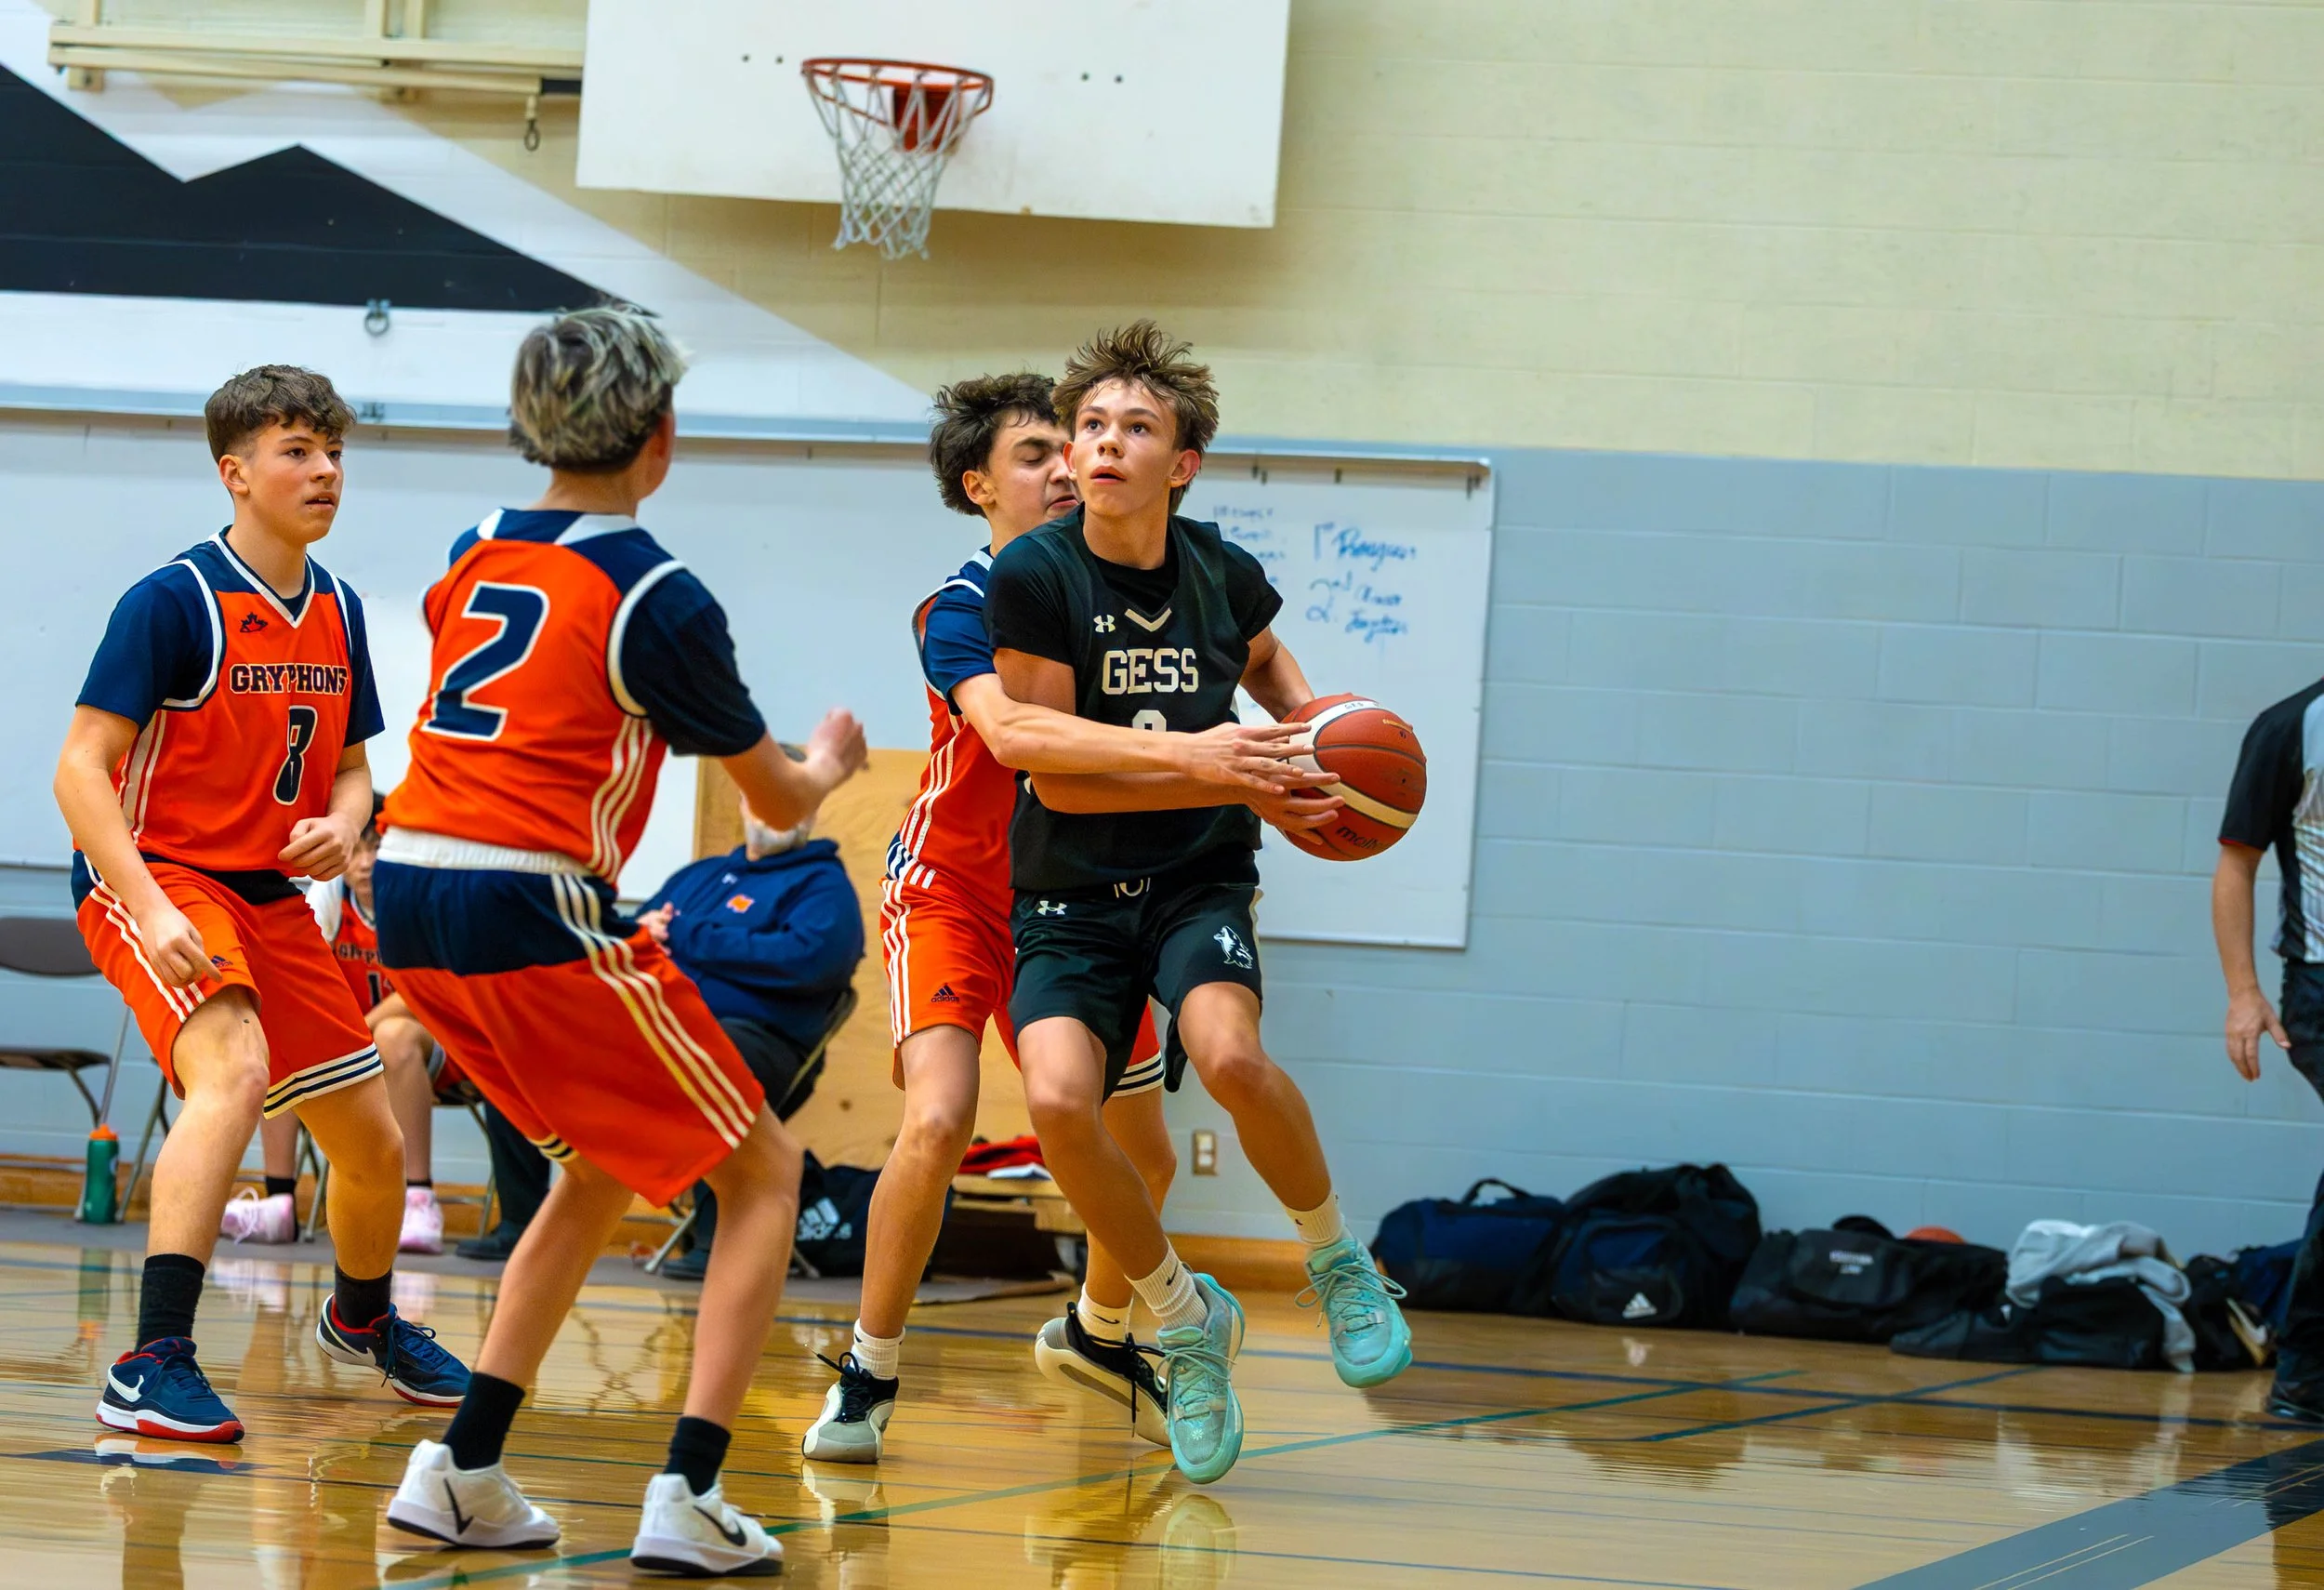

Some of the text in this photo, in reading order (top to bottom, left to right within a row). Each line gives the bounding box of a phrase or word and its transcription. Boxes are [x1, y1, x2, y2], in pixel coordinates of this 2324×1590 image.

[230, 663, 349, 696] GRYPHONS
[420, 580, 549, 742] 2
[1102, 648, 1199, 695] GESS
[272, 705, 318, 806] 8
